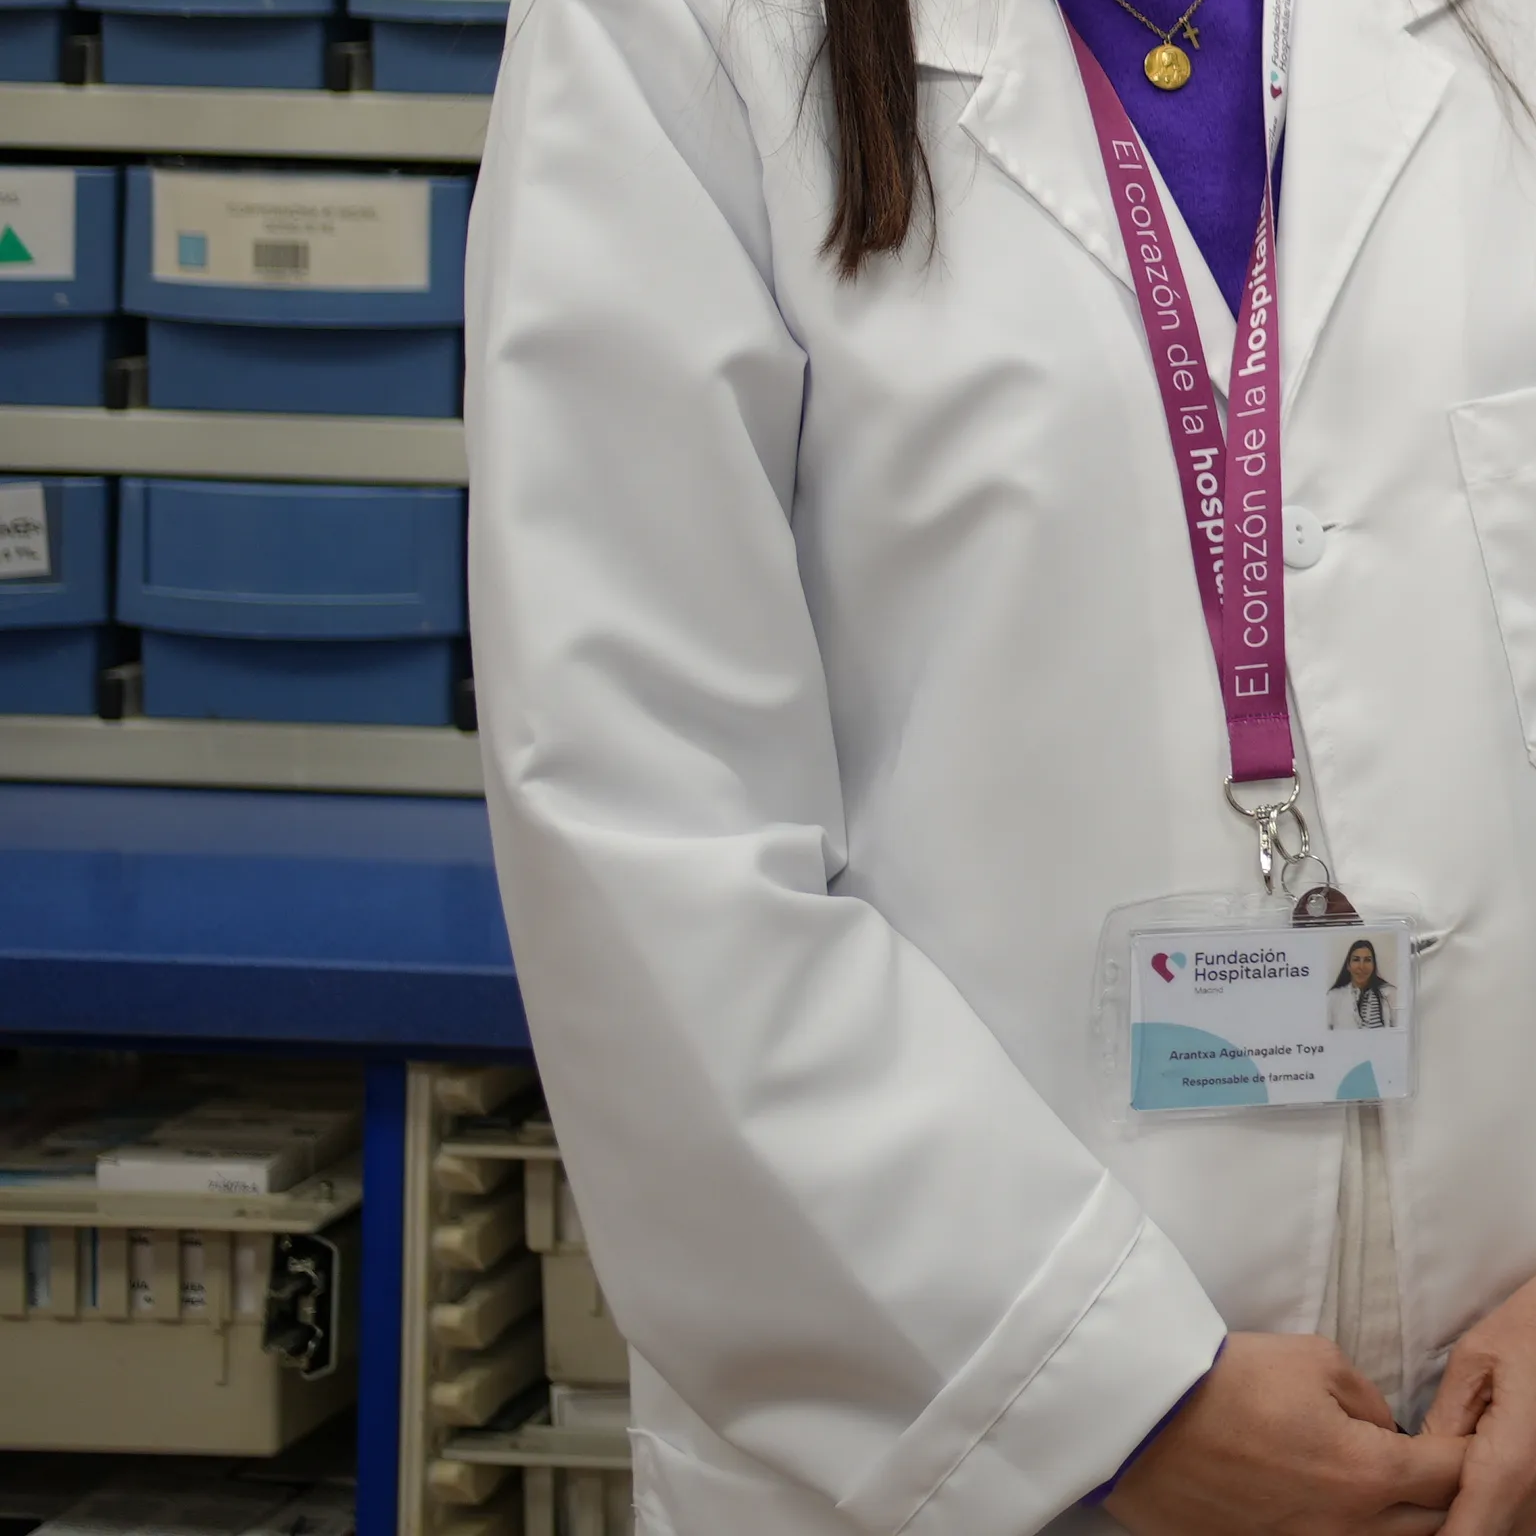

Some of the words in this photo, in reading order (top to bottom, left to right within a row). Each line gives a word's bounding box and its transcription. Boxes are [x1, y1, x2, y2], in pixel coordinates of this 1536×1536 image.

[1112, 139, 1144, 170] El
[1125, 182, 1182, 331] corazón
[1167, 343, 1199, 393] de
[1236, 384, 1266, 418] la
[1180, 404, 1209, 436] la
[1235, 427, 1266, 477] de
[1234, 488, 1268, 649] corazón
[1234, 663, 1269, 697] El
[1194, 963, 1311, 984] Hospitalarias
[1195, 948, 1287, 967] Fundación
[1169, 1049, 1216, 1062] Arantxa
[1220, 1045, 1292, 1060] Aguinagalde
[1296, 1044, 1325, 1057] Toya
[1182, 1074, 1249, 1089] Responsable
[1252, 1073, 1266, 1084] de
